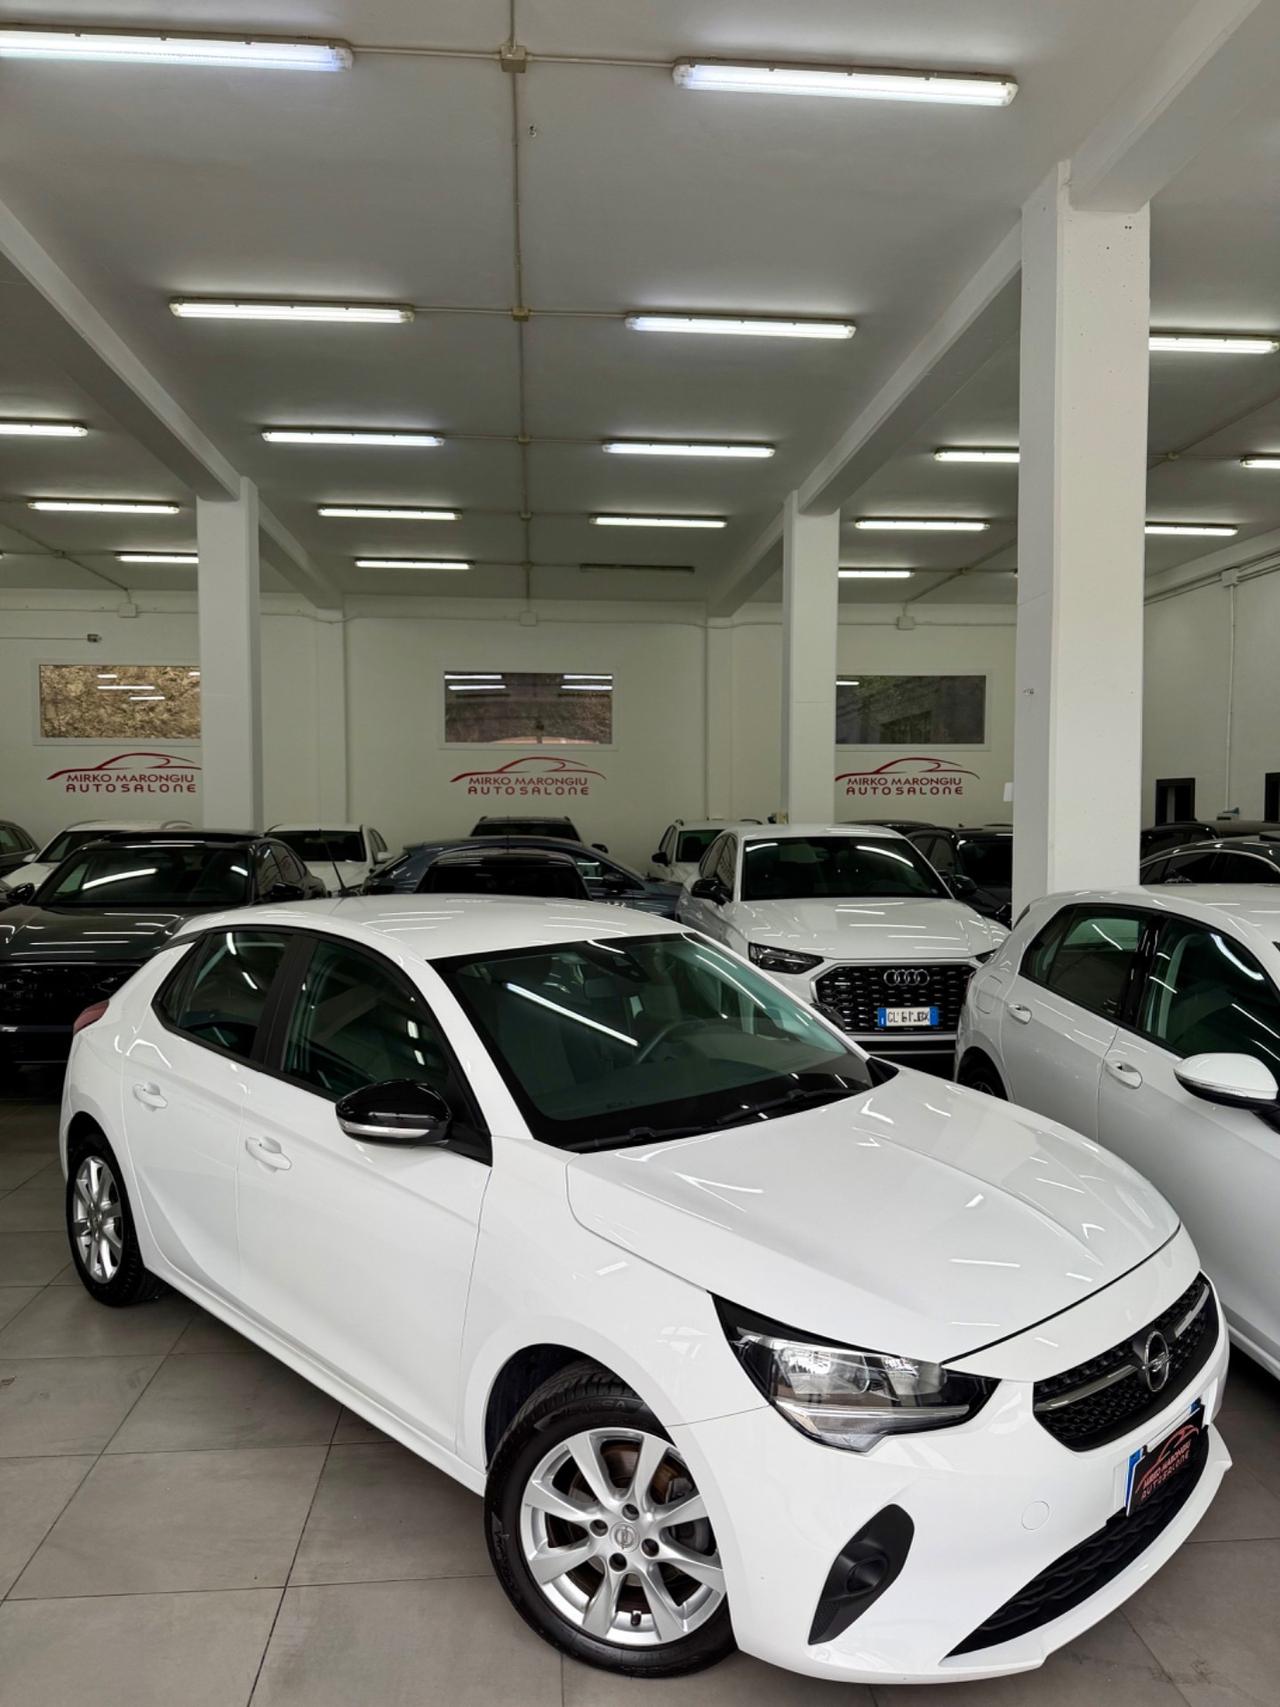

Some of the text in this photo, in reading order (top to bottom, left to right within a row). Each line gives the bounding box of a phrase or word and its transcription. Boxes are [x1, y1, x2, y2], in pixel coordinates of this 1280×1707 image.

[66, 774, 194, 783] MIRKO MARONGIU
[469, 777, 588, 785] MIRKO MARONGIU
[847, 777, 962, 786] MIRKO MARONGIU
[66, 784, 196, 793] AUTOSALONE
[467, 786, 589, 795] AUTOSALONE
[846, 786, 963, 795] AUTOSALONE
